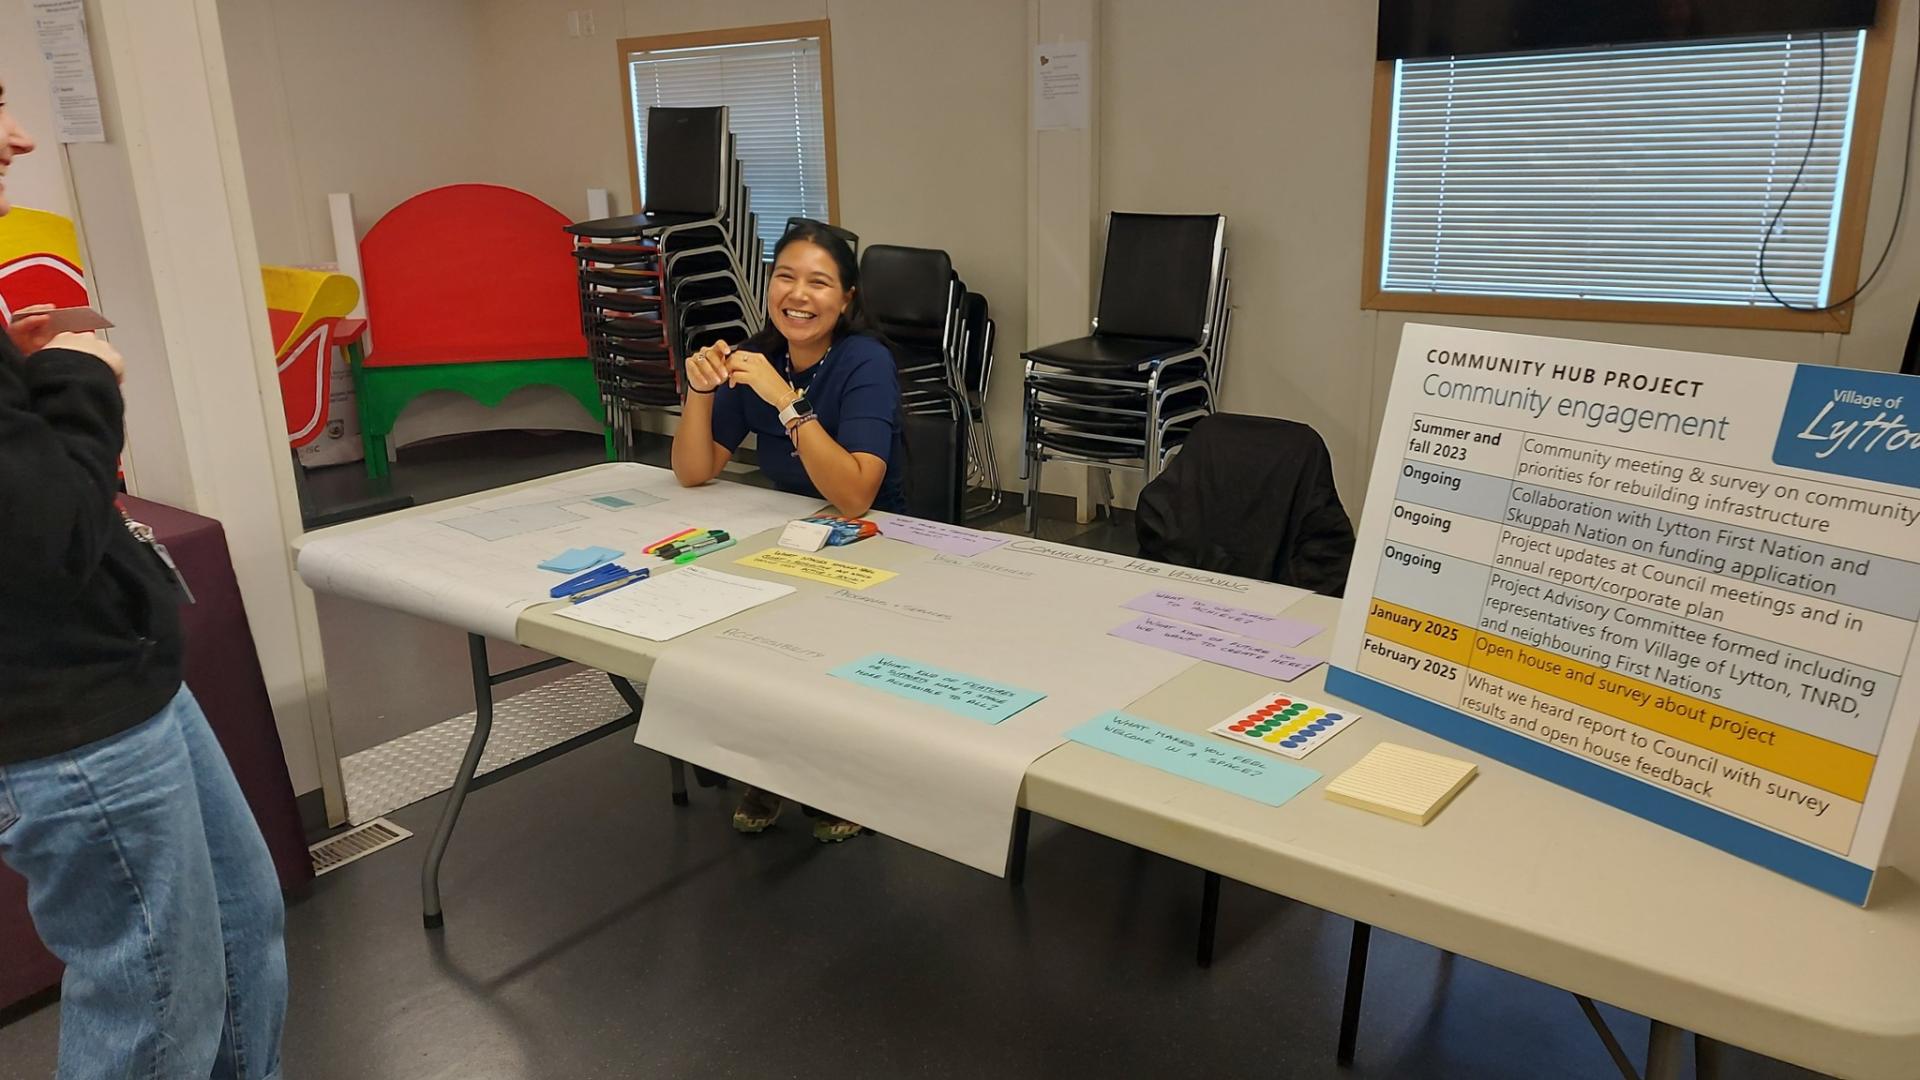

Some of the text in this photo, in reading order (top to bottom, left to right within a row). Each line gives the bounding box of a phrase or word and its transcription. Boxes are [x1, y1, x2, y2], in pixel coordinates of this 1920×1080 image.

[1427, 349, 1703, 397] COMMUNITY HUB PROJECT
[1423, 373, 1730, 440] Community engagement
[1834, 389, 1904, 409] Village of
[1409, 438, 1467, 461] fall 2023
[1413, 419, 1502, 446] Summer and
[1403, 465, 1461, 490] Ongoing
[1518, 461, 1830, 532] priorities for rebuilding infrastructure
[1524, 438, 1920, 527] Community meeting & survey on community
[1394, 505, 1451, 533] Ongoing
[1512, 487, 1870, 576] Collaboration with Lytton First Nation and
[1010, 540, 1249, 591] COMMUNITY HUB VISIONING
[1385, 545, 1442, 574] Ongoing
[1507, 507, 1837, 595] Skuppah Nation on funding application
[1156, 591, 1184, 601] WHAT
[1242, 612, 1276, 622] WANT
[1496, 554, 1724, 622] annual report/corporate plan
[1501, 530, 1863, 632] Project updates at Council meetings and in
[1146, 616, 1177, 629] WHAT
[1181, 628, 1202, 638] KIND
[1229, 641, 1270, 654] FUTURE
[1192, 606, 1254, 624] ACHIEVE?
[1371, 604, 1459, 641] January 2025
[1491, 573, 1876, 697] Project Advisory Committee formed including
[1136, 624, 1154, 632] WE
[1164, 632, 1197, 642] WANT
[1220, 646, 1265, 660] CREATE
[1271, 658, 1312, 670] HERE?
[1364, 639, 1458, 680] February 2025
[1481, 616, 1723, 699] and neighbouring First Nations
[1486, 596, 1859, 718] representatives from Village of Lytton, TNRD,
[855, 669, 882, 679] MORE
[966, 699, 999, 711] ALL?
[878, 657, 910, 670] WHAT
[963, 681, 1016, 698] FEATURES
[1476, 637, 1776, 745] Open house and survey about project
[1104, 724, 1153, 745] WELCOME
[1207, 757, 1263, 777] SPACE?
[1112, 715, 1150, 731] WHAT
[1155, 730, 1195, 748] MAKES
[1204, 745, 1225, 758] YOU
[1232, 754, 1267, 770] FEEL
[1462, 695, 1714, 797] results and open house feedback
[1468, 673, 1830, 816] What we heard report to Council with survey
